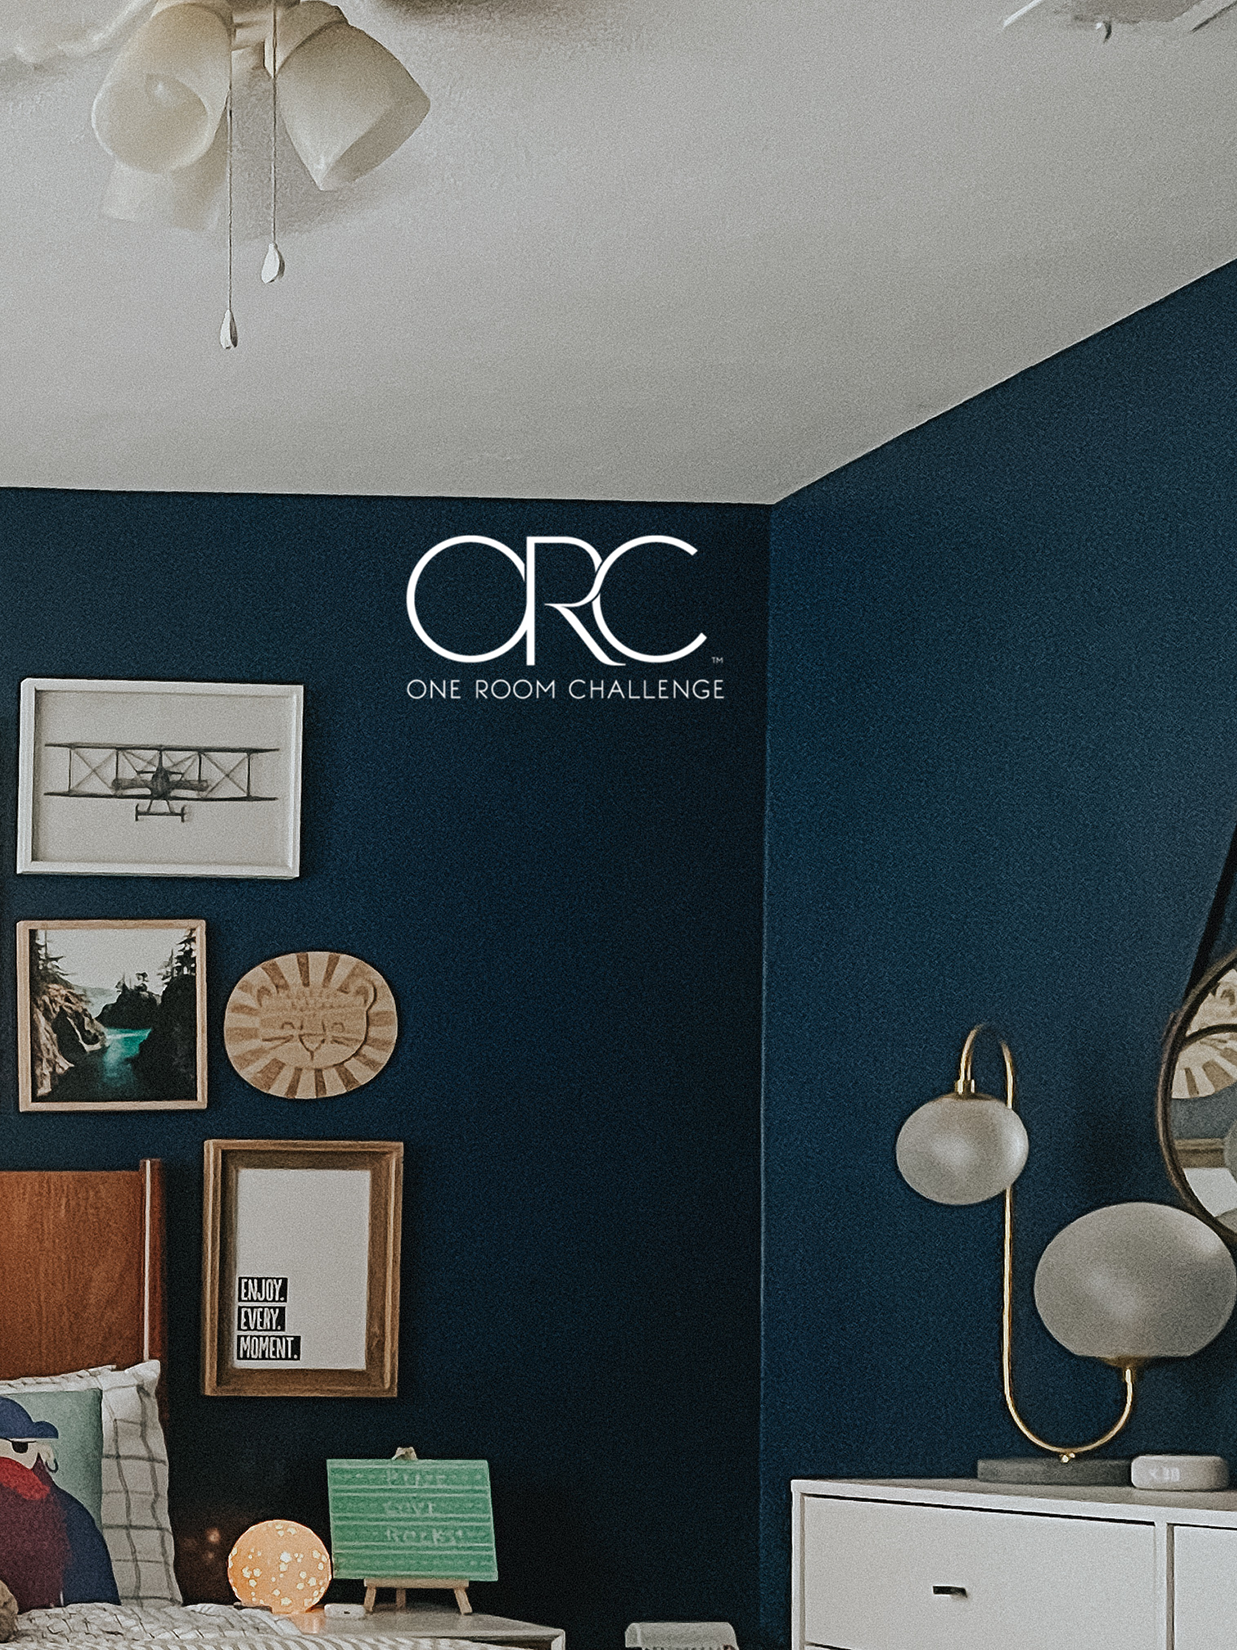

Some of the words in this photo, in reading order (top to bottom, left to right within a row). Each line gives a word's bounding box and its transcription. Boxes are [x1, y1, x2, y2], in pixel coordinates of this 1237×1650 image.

[241, 1279, 285, 1301] ENJOY.
[241, 1307, 281, 1330] EVERY.
[240, 1335, 299, 1359] MOMENT.
